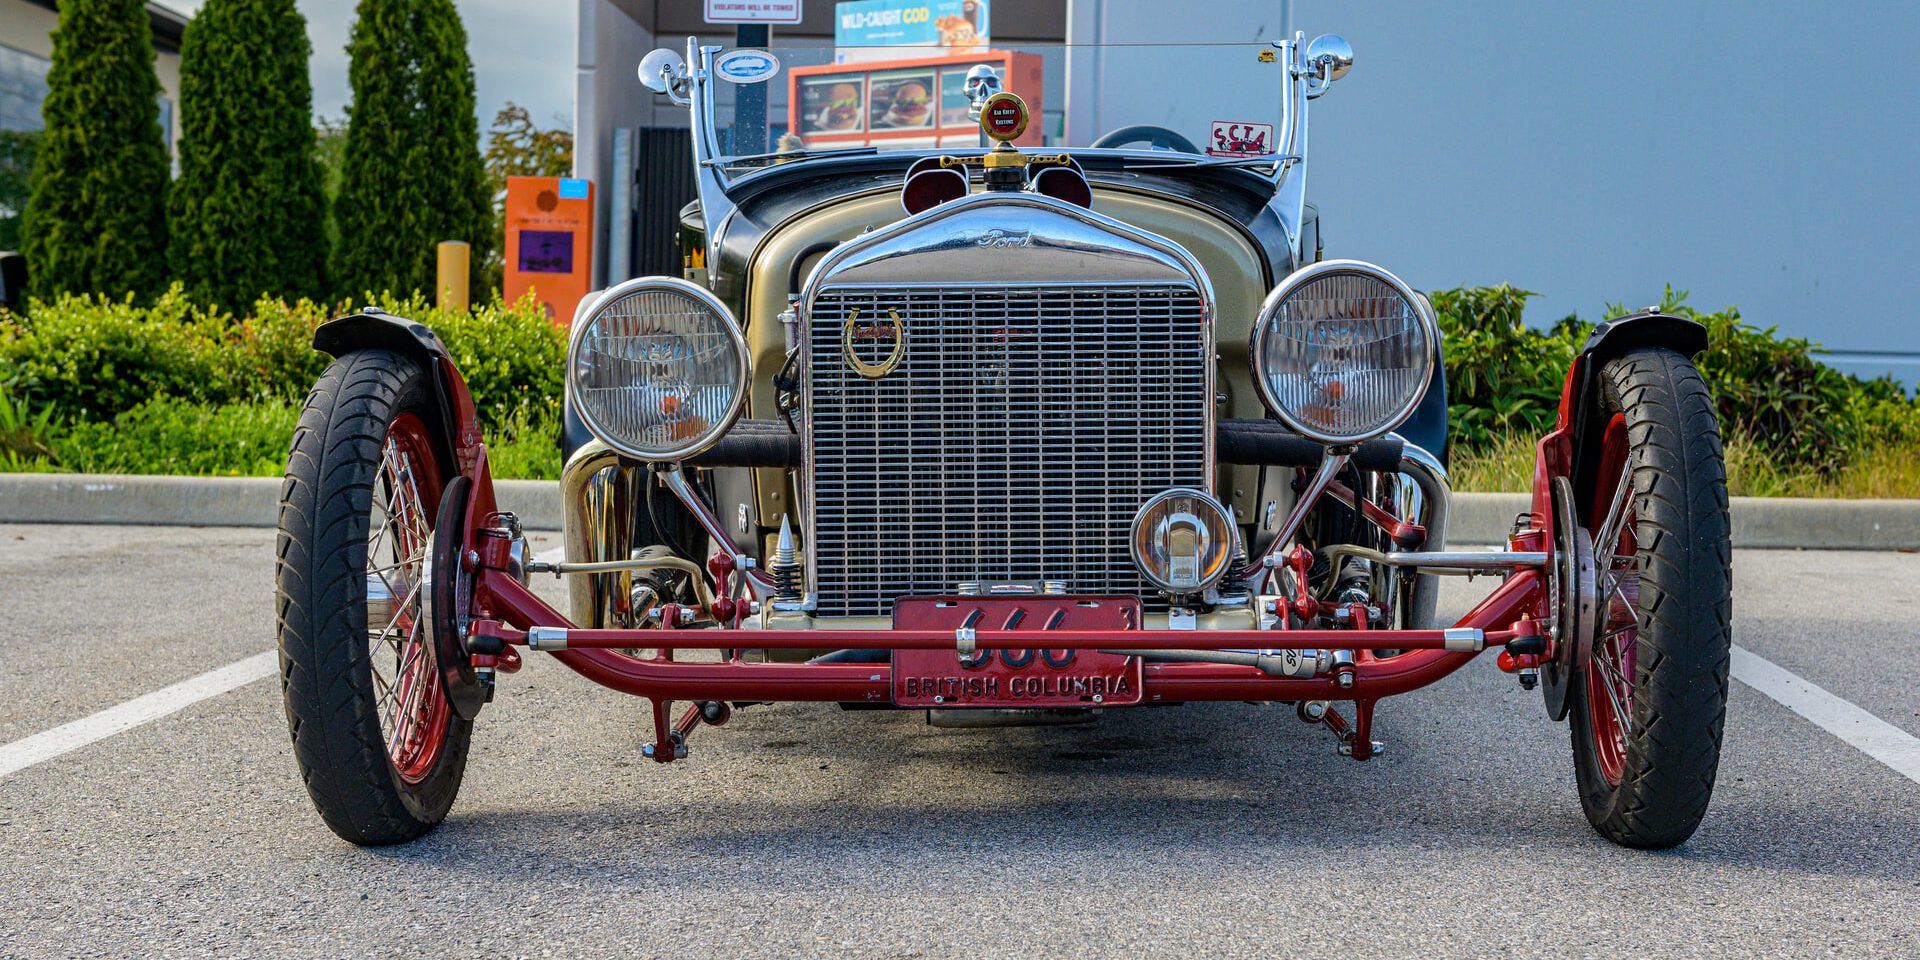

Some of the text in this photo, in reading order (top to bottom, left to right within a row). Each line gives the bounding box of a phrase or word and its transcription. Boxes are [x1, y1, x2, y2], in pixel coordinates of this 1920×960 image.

[841, 7, 929, 29] WILD-CAUGHT COD
[978, 229, 1032, 248] Ford
[905, 676, 1131, 697] BRITISH COLUMBIA
